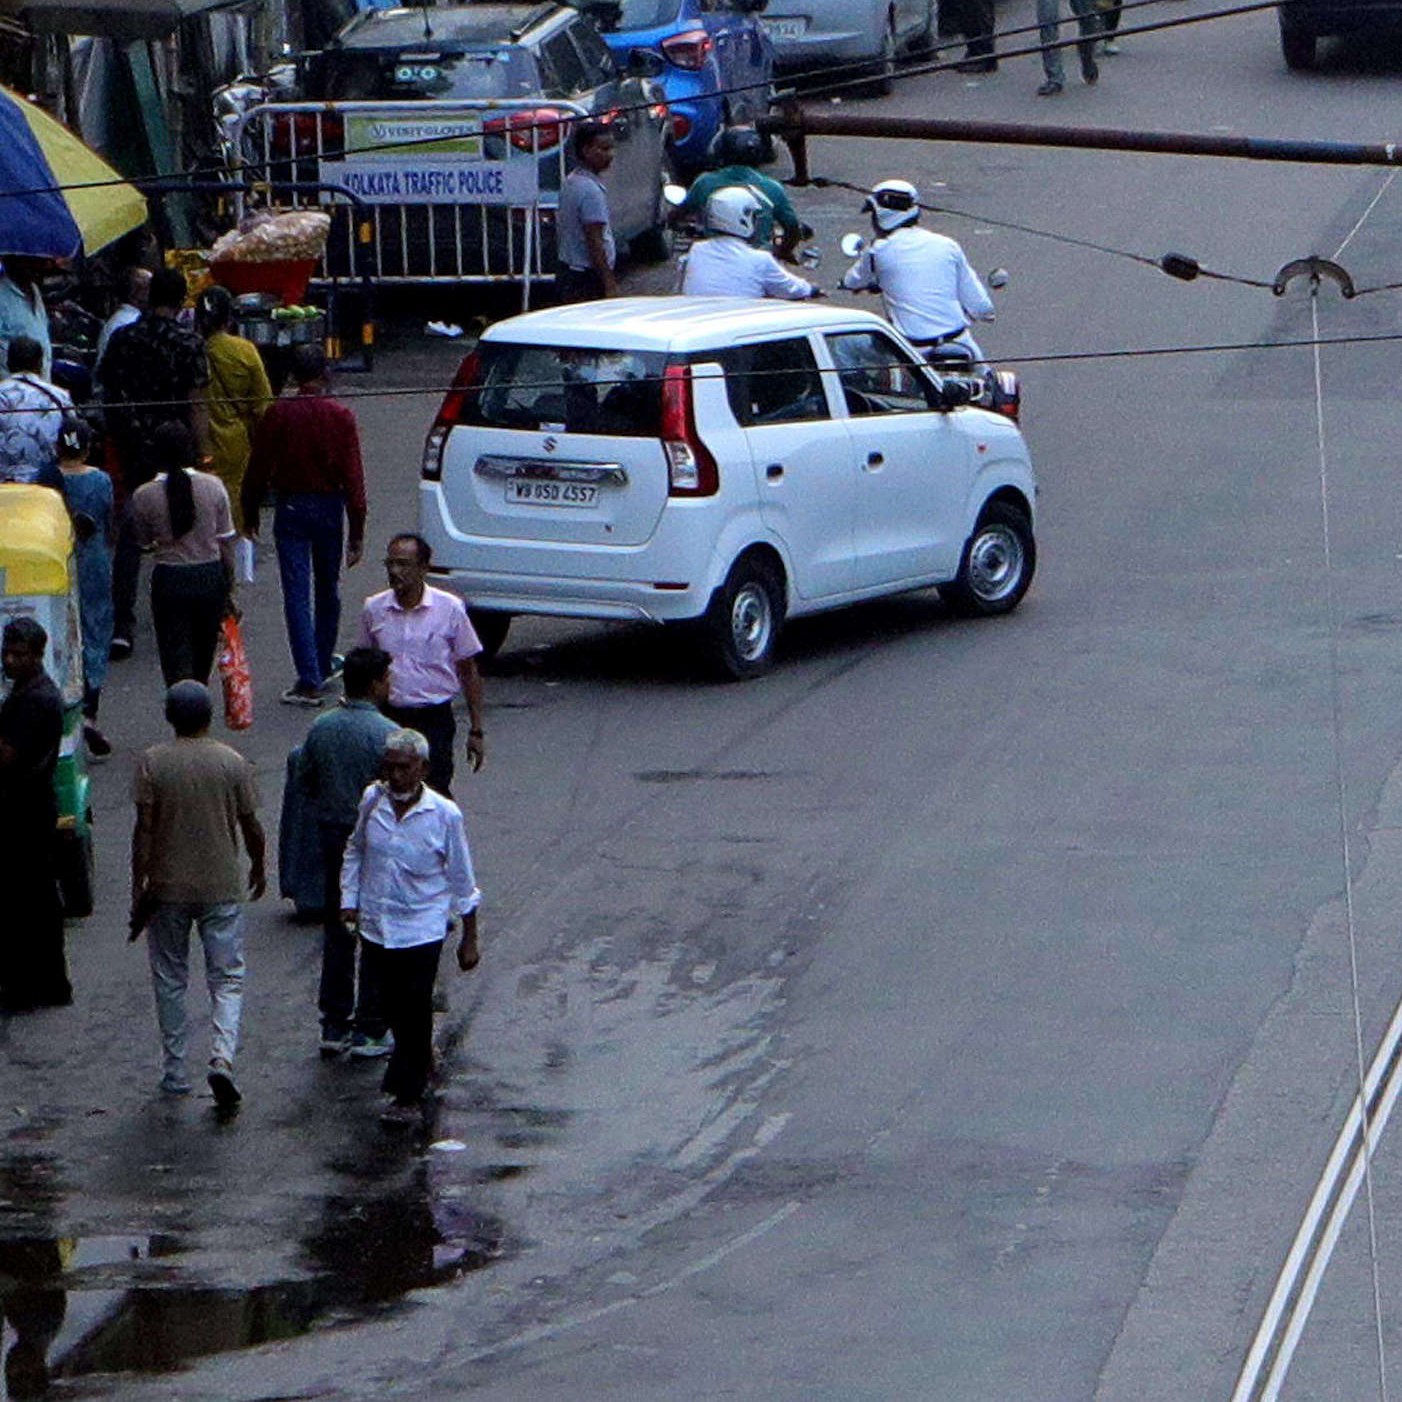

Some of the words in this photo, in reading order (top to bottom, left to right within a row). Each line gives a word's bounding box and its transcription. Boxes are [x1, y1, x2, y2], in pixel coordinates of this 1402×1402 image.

[342, 171, 400, 196] KOLKATA
[404, 171, 455, 196] TRAFFIC
[458, 170, 503, 195] POLICE
[516, 482, 531, 498] WB
[562, 485, 596, 502] 4557
